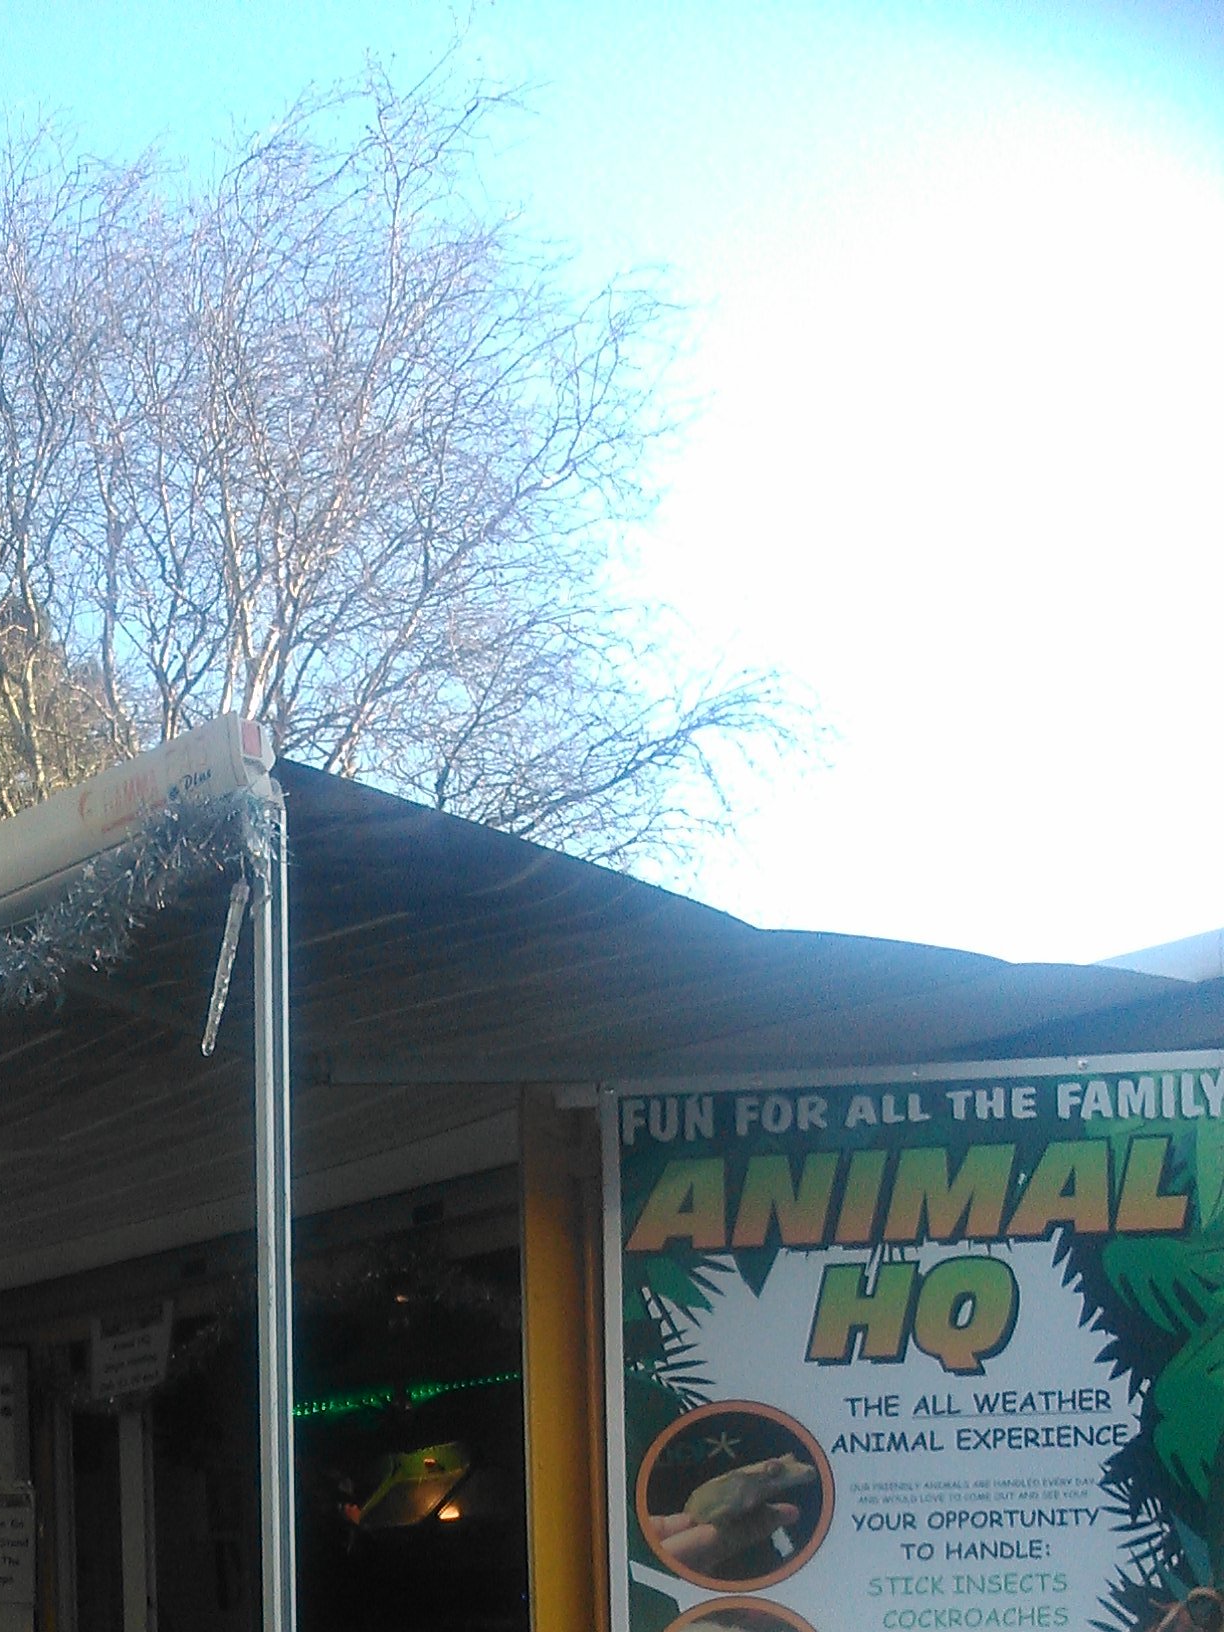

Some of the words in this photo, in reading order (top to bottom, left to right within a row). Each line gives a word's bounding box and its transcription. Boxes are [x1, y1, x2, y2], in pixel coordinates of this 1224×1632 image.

[622, 1095, 714, 1145] FUN
[735, 1096, 828, 1136] FOR
[844, 1093, 930, 1129] ALL
[947, 1088, 1038, 1121] THE
[1056, 1074, 1224, 1121] FAMILY
[625, 1135, 1192, 1254] ANIMAL
[804, 1256, 1019, 1376] HQ
[846, 1397, 900, 1419] THE
[913, 1395, 962, 1416] ALL
[973, 1389, 1112, 1415] WEATHER
[831, 1430, 944, 1454] ANIMAL
[957, 1424, 1128, 1451] EXPERIENCE
[1042, 1477, 1071, 1488] EVERY
[851, 1511, 917, 1532] YOUR
[926, 1507, 1102, 1530] OPPORTUNITY
[900, 1542, 934, 1560] TO
[945, 1540, 1052, 1560] HANDLE:
[867, 1575, 944, 1597] STICK
[953, 1572, 1068, 1595] INSECTS
[882, 1606, 1070, 1630] COCKROACHES
